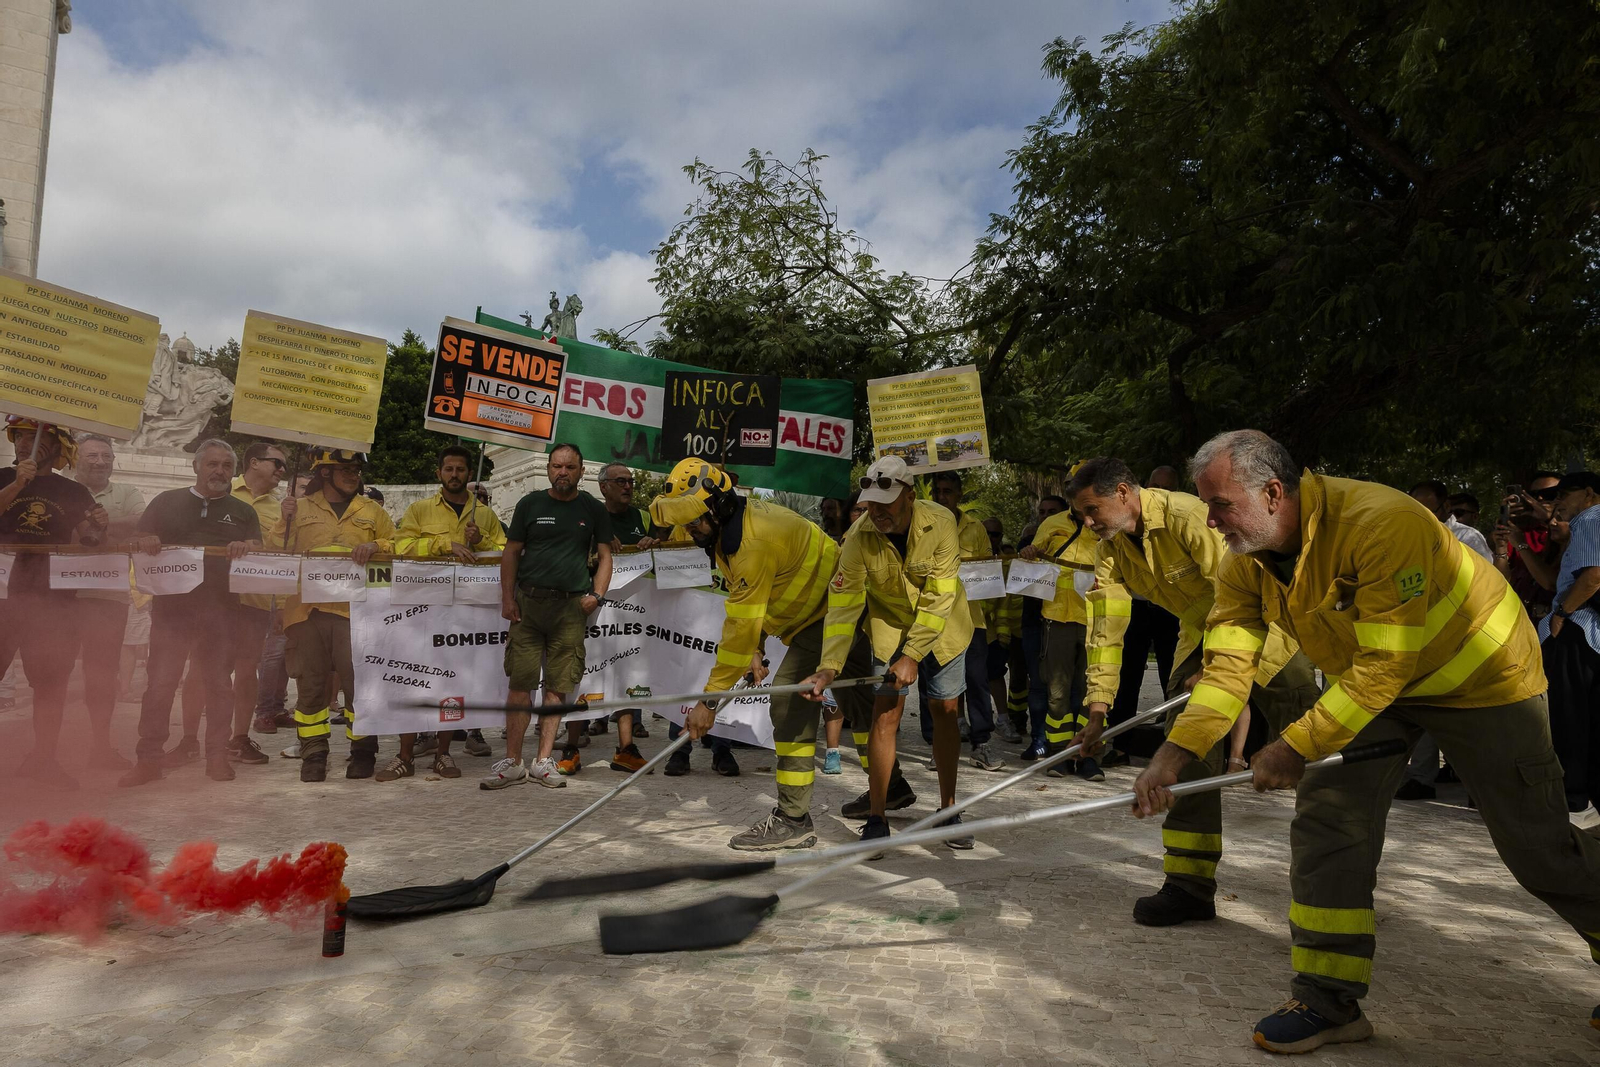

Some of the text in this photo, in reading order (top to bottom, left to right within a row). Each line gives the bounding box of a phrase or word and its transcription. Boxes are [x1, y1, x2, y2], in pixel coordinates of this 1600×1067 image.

[27, 286, 129, 322] PP DE JUANMA MORENO
[2, 296, 145, 344] JUEGA CON NUESTROS DERECHOS:
[11, 316, 68, 337] ANTIGÜEDAD
[6, 332, 60, 351] ESTABILIDAD
[258, 335, 303, 350] DESPILFARRA
[314, 347, 339, 357] DINERO
[298, 329, 327, 340] JUANMA
[331, 336, 361, 348] MORENO
[282, 356, 316, 367] MILLONES
[345, 367, 379, 379] CAMIONES
[441, 335, 562, 386] SE VENDE
[60, 363, 107, 380] MOVILIDAD
[260, 366, 366, 391] AUTOBOMBA CON PROBLEMAS
[111, 392, 144, 406] CALIDAD
[262, 380, 303, 393] MECÁNICOS
[312, 389, 344, 401] TÉCNICOS
[467, 377, 552, 408] INFOCA
[563, 378, 647, 419] EROS
[673, 378, 765, 408] INFOCA
[54, 394, 98, 410] COLECTIVA
[244, 392, 371, 420] COMPROMETEN NUESTRA SEGURIDAD
[490, 406, 523, 416] PREGUNTAR
[478, 414, 531, 428] JUANMA MORENO
[61, 570, 119, 578] ESTAMOS
[142, 563, 197, 575] VENDIDOS
[233, 567, 296, 577] ANDALUCÍA
[658, 563, 708, 572] FUNDAMENTALES
[307, 573, 360, 582] SE QUEMA
[395, 575, 451, 584] BOMBEROS
[1023, 578, 1056, 588] PERMUTAS
[1400, 573, 1422, 587] 112
[384, 604, 429, 625] SIN EPIS
[646, 624, 670, 642] SIN
[365, 655, 456, 678] SIN ESTABILIDAD
[382, 673, 431, 689] LABORAL
